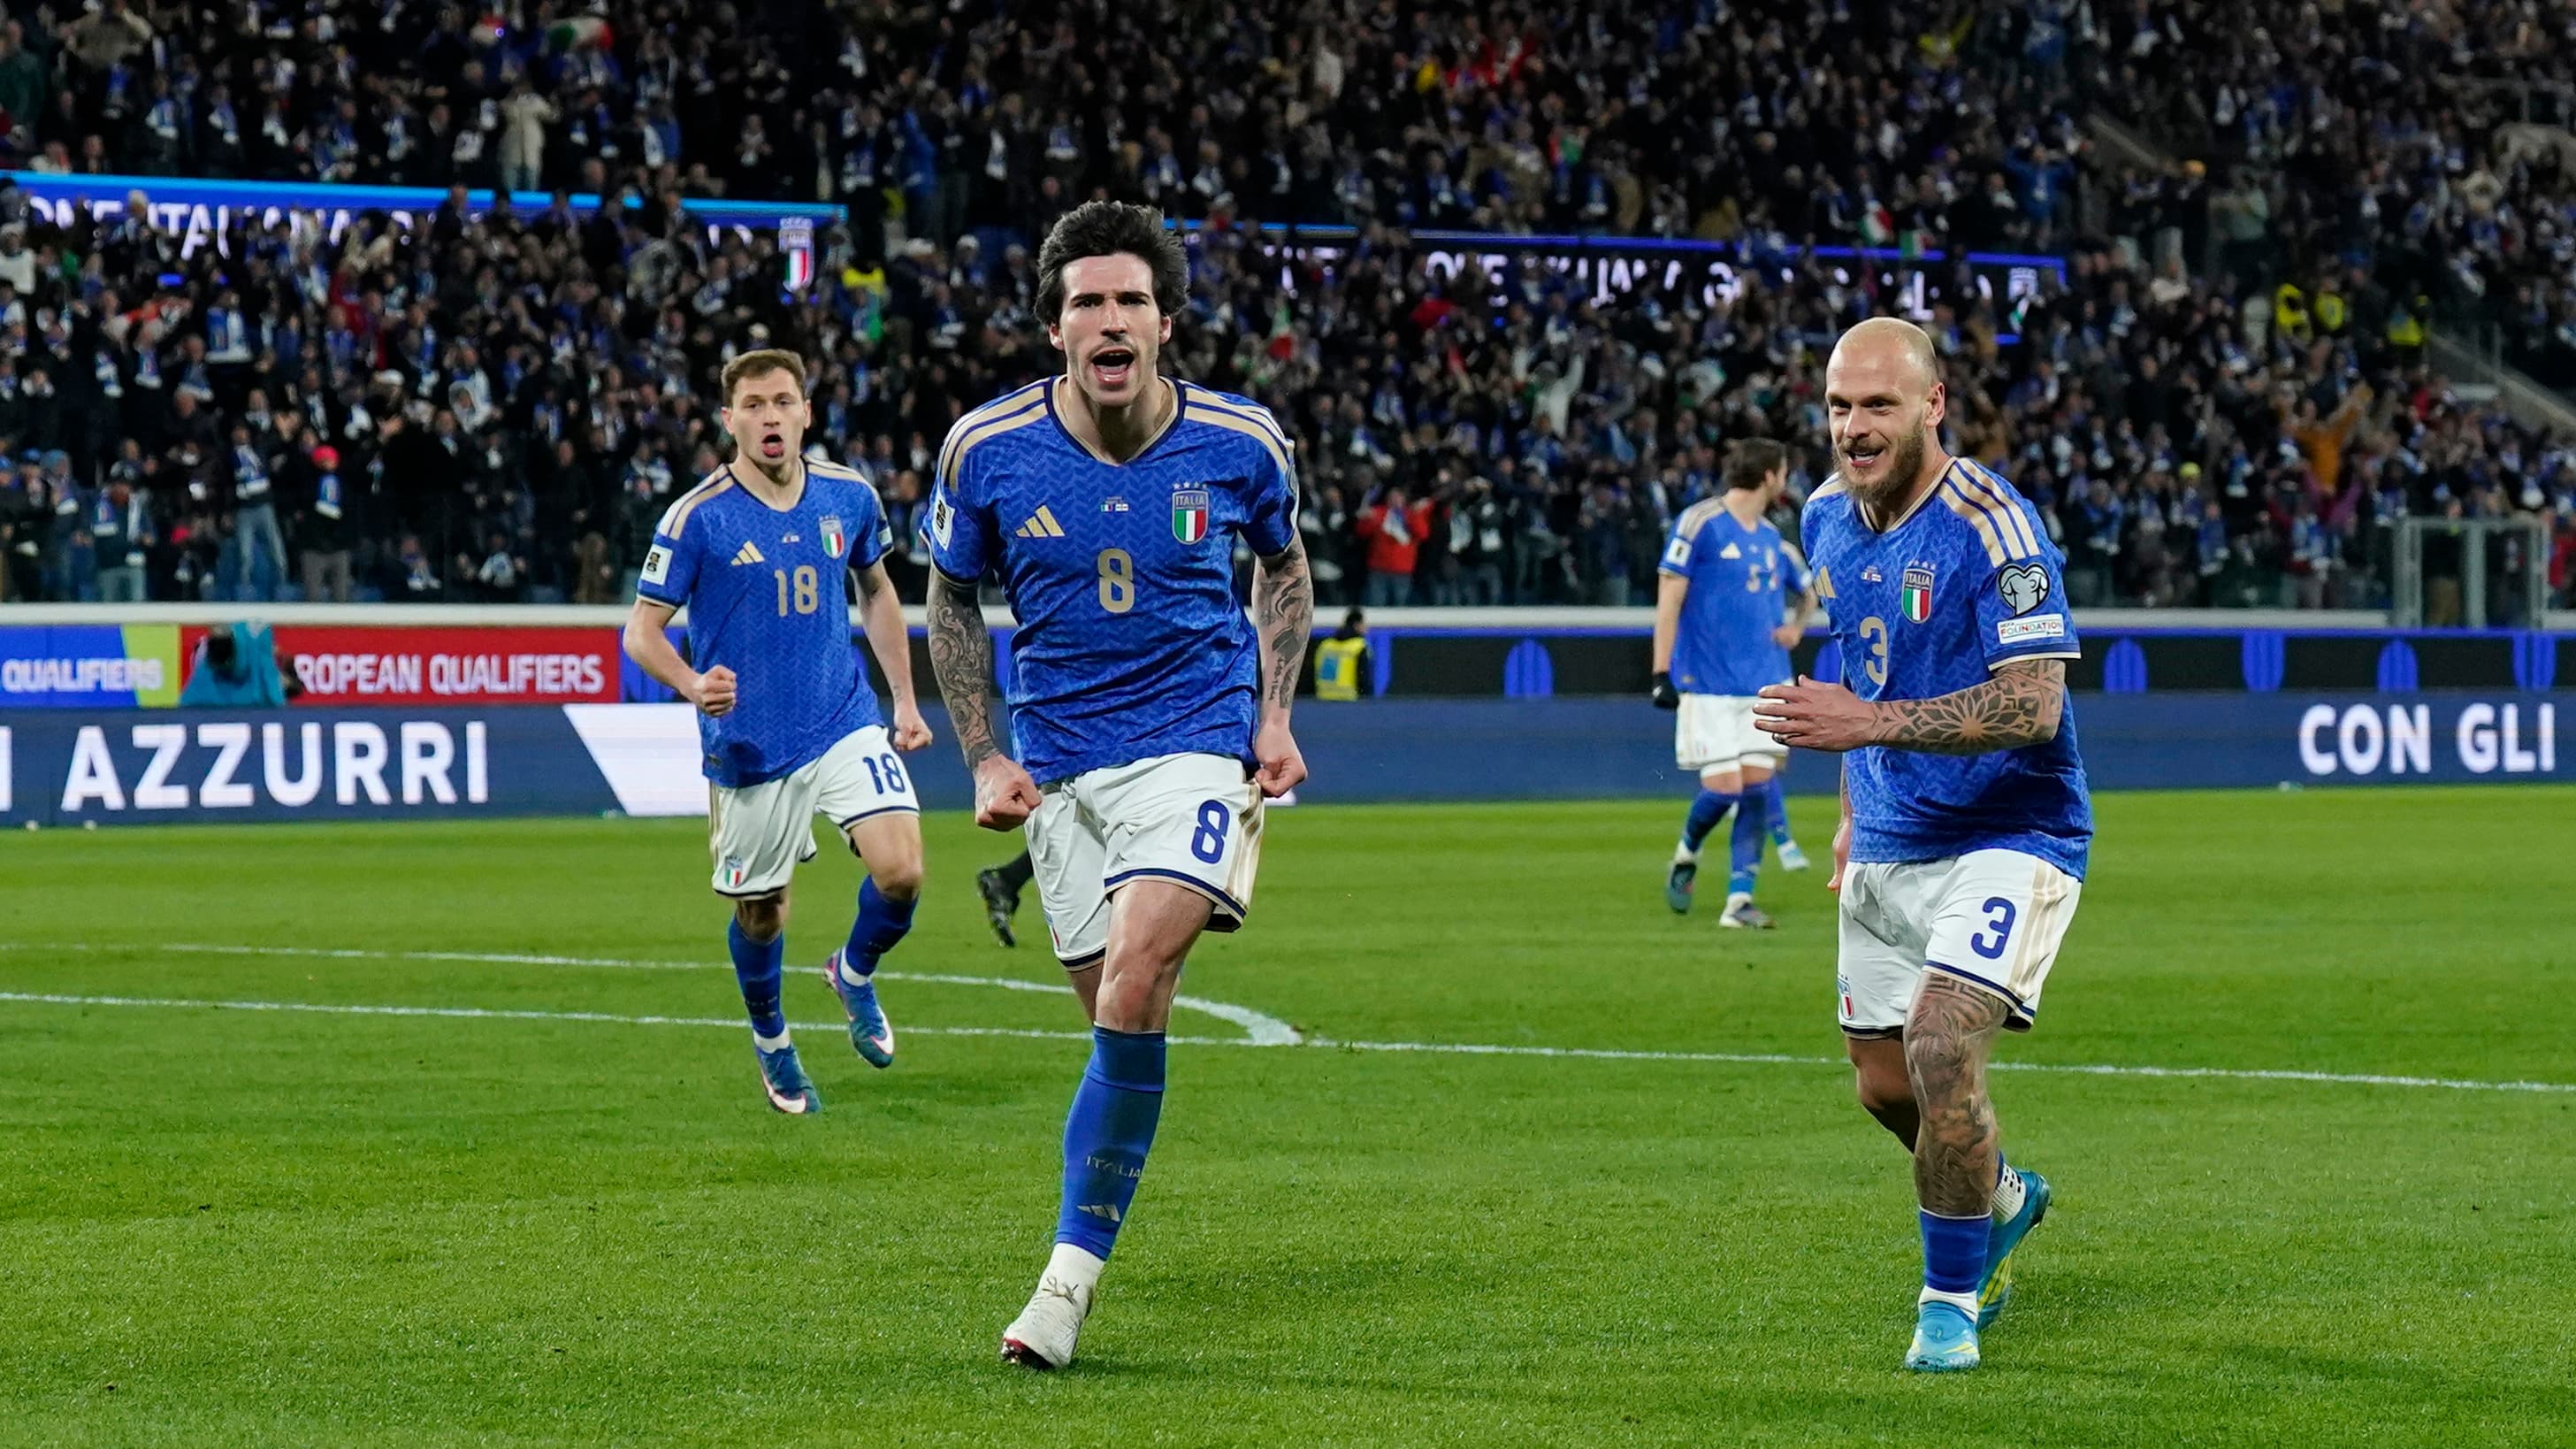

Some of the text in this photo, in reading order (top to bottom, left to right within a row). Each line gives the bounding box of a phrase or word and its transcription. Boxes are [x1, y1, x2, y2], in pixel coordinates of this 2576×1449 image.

[1175, 495, 1205, 506] ITALIA
[775, 565, 818, 617] 18
[1097, 548, 1135, 613] 8
[1906, 572, 1930, 585] ITALIA
[1, 658, 164, 693] QUALIFIERS
[294, 653, 605, 694] ROPEAN QUALIFIERS
[1859, 617, 1888, 686] 3
[2299, 702, 2556, 775] CON GLI
[60, 721, 488, 812] AZZURRI
[862, 753, 906, 795] 18
[1191, 799, 1230, 864] 8
[1970, 896, 2016, 960] 3
[1086, 1155, 1142, 1178] ITALIA
